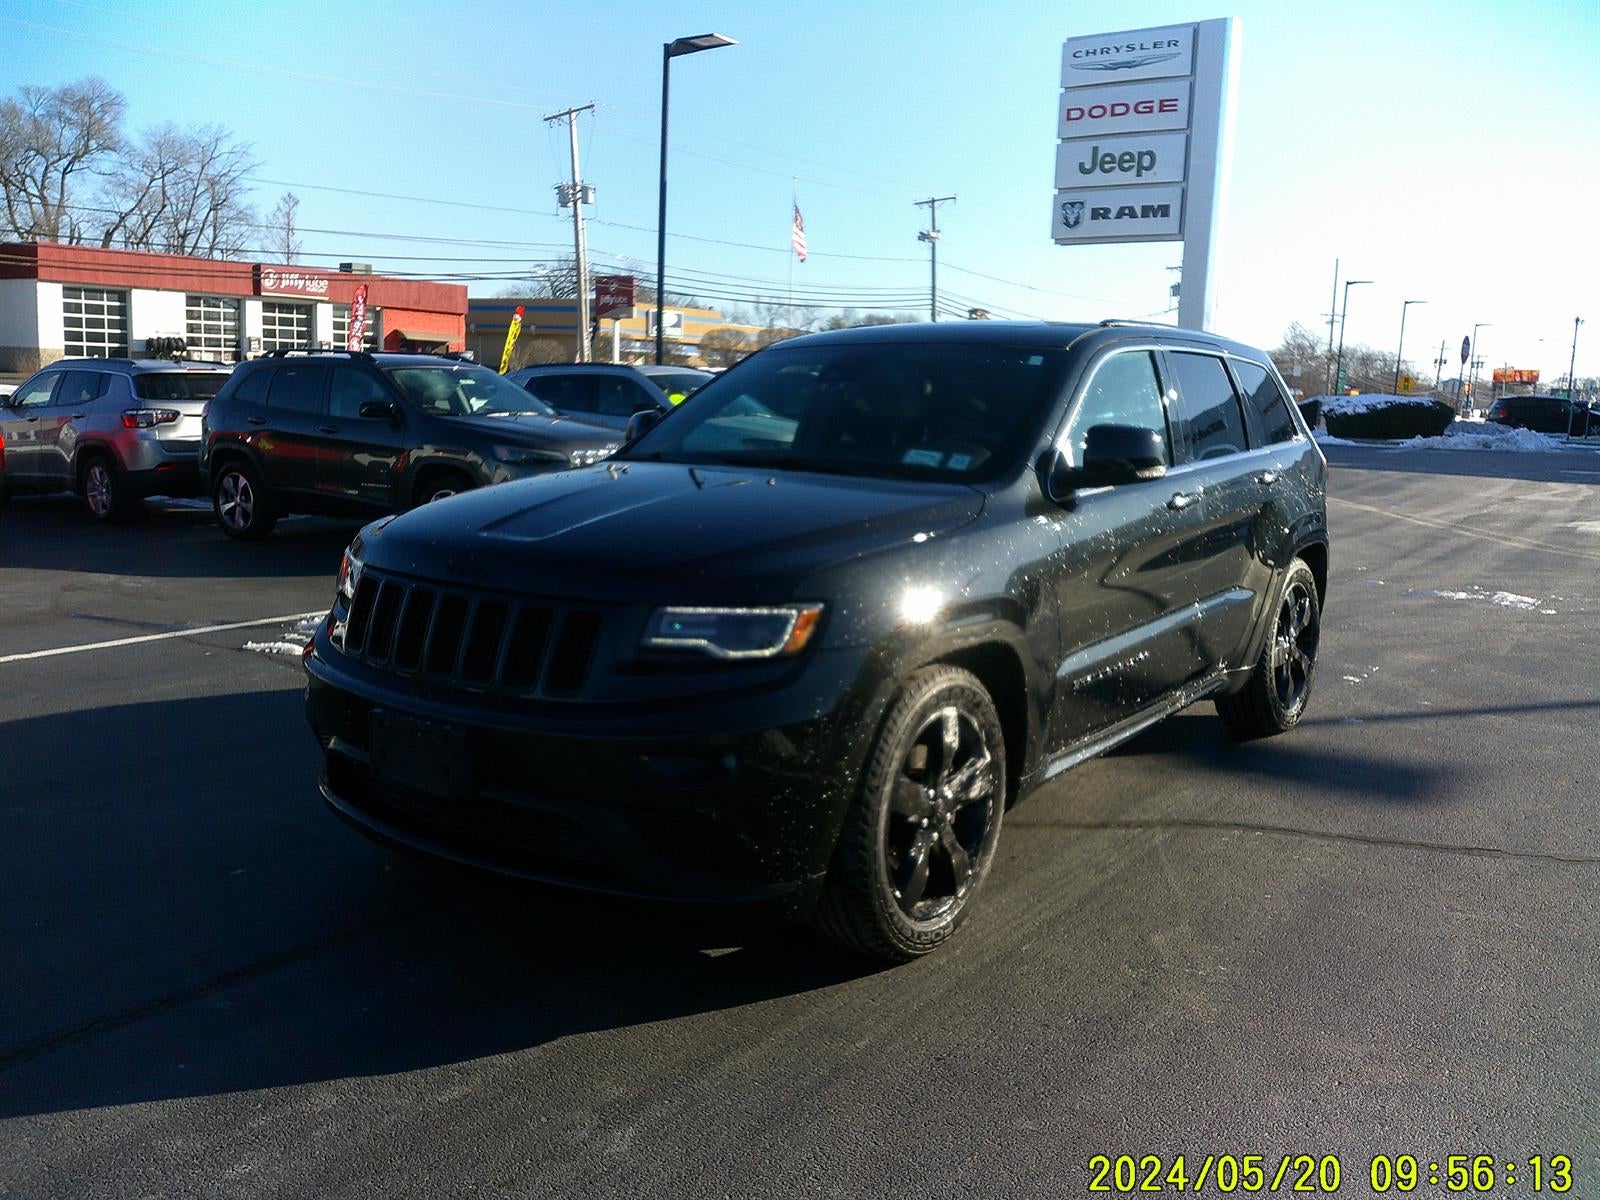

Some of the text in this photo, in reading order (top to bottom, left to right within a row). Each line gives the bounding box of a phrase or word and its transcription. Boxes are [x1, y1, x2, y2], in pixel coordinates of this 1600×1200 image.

[1072, 39, 1180, 59] CHRYSLER
[1066, 98, 1179, 122] DODGE
[1078, 146, 1157, 177] Jeep
[1090, 204, 1171, 220] RAM
